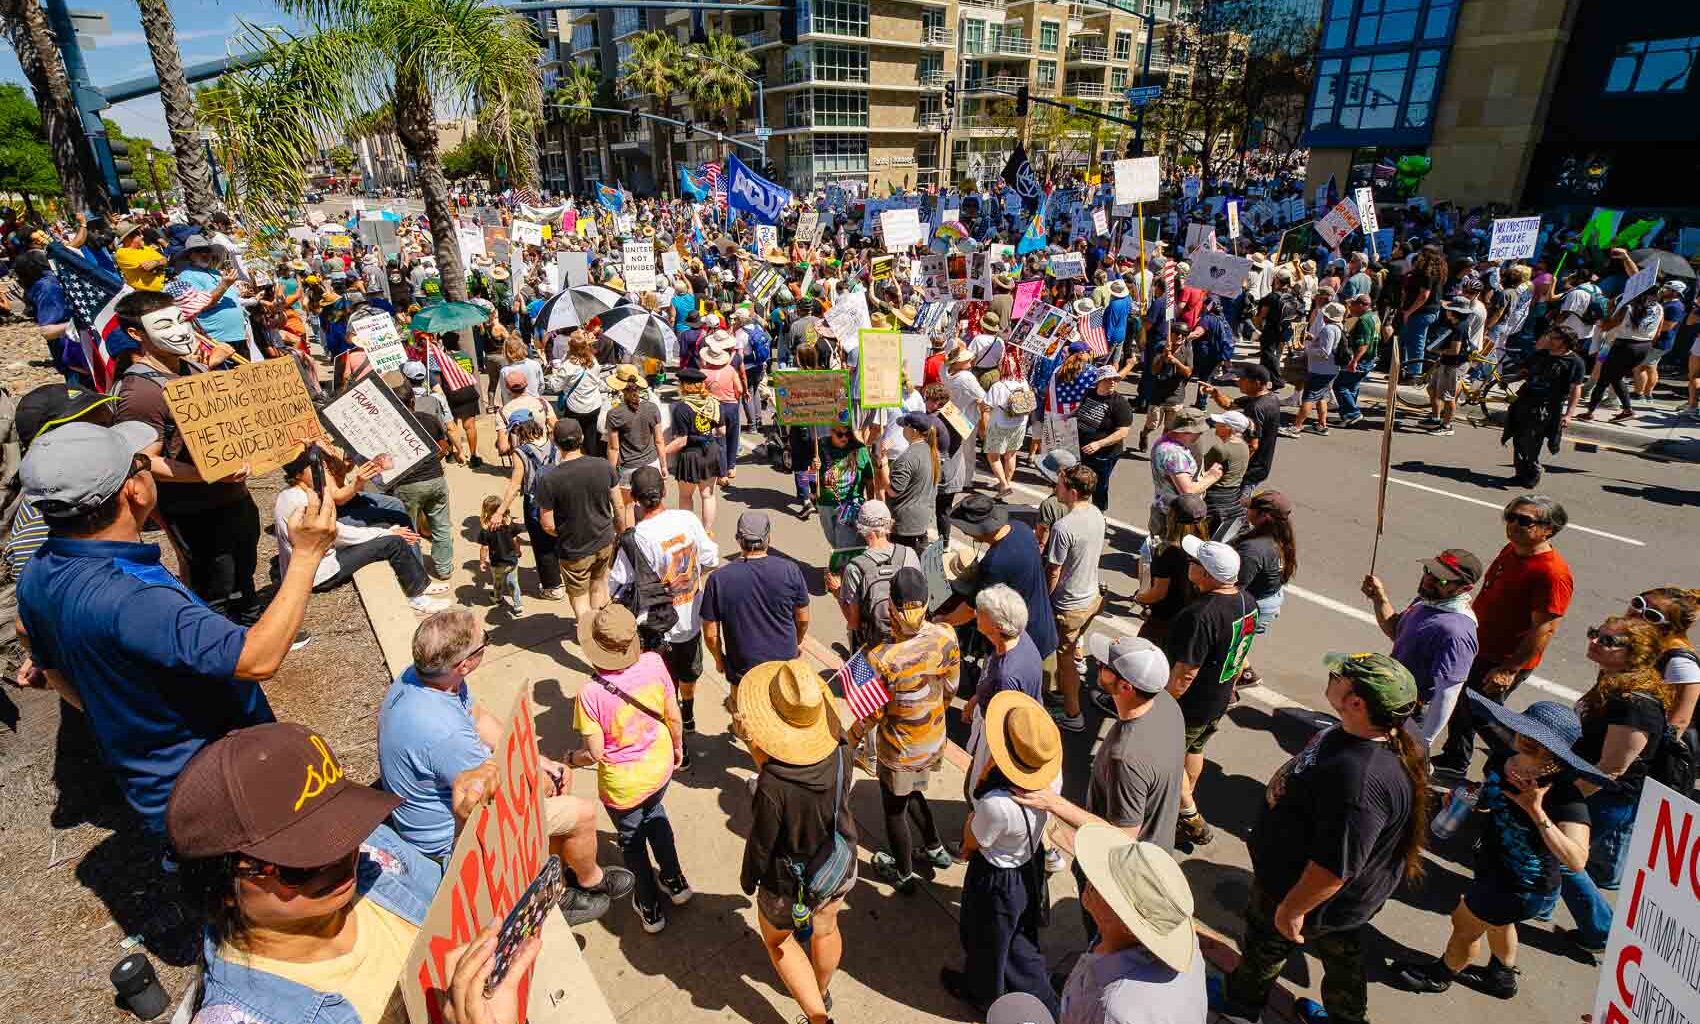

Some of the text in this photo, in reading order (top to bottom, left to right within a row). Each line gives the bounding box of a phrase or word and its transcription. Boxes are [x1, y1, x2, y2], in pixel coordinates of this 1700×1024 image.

[1490, 244, 1531, 258] FIRST LADY
[1517, 232, 1526, 243] BE
[164, 381, 195, 402] LET
[201, 375, 229, 395] ME
[265, 364, 284, 380] RISK
[175, 379, 306, 424] SOUNDING RIDICULOUS
[351, 388, 379, 415] TRUMP
[184, 425, 218, 448] THE
[216, 416, 254, 439] TRUE
[203, 448, 220, 467] IS
[221, 432, 275, 462] GUIDED
